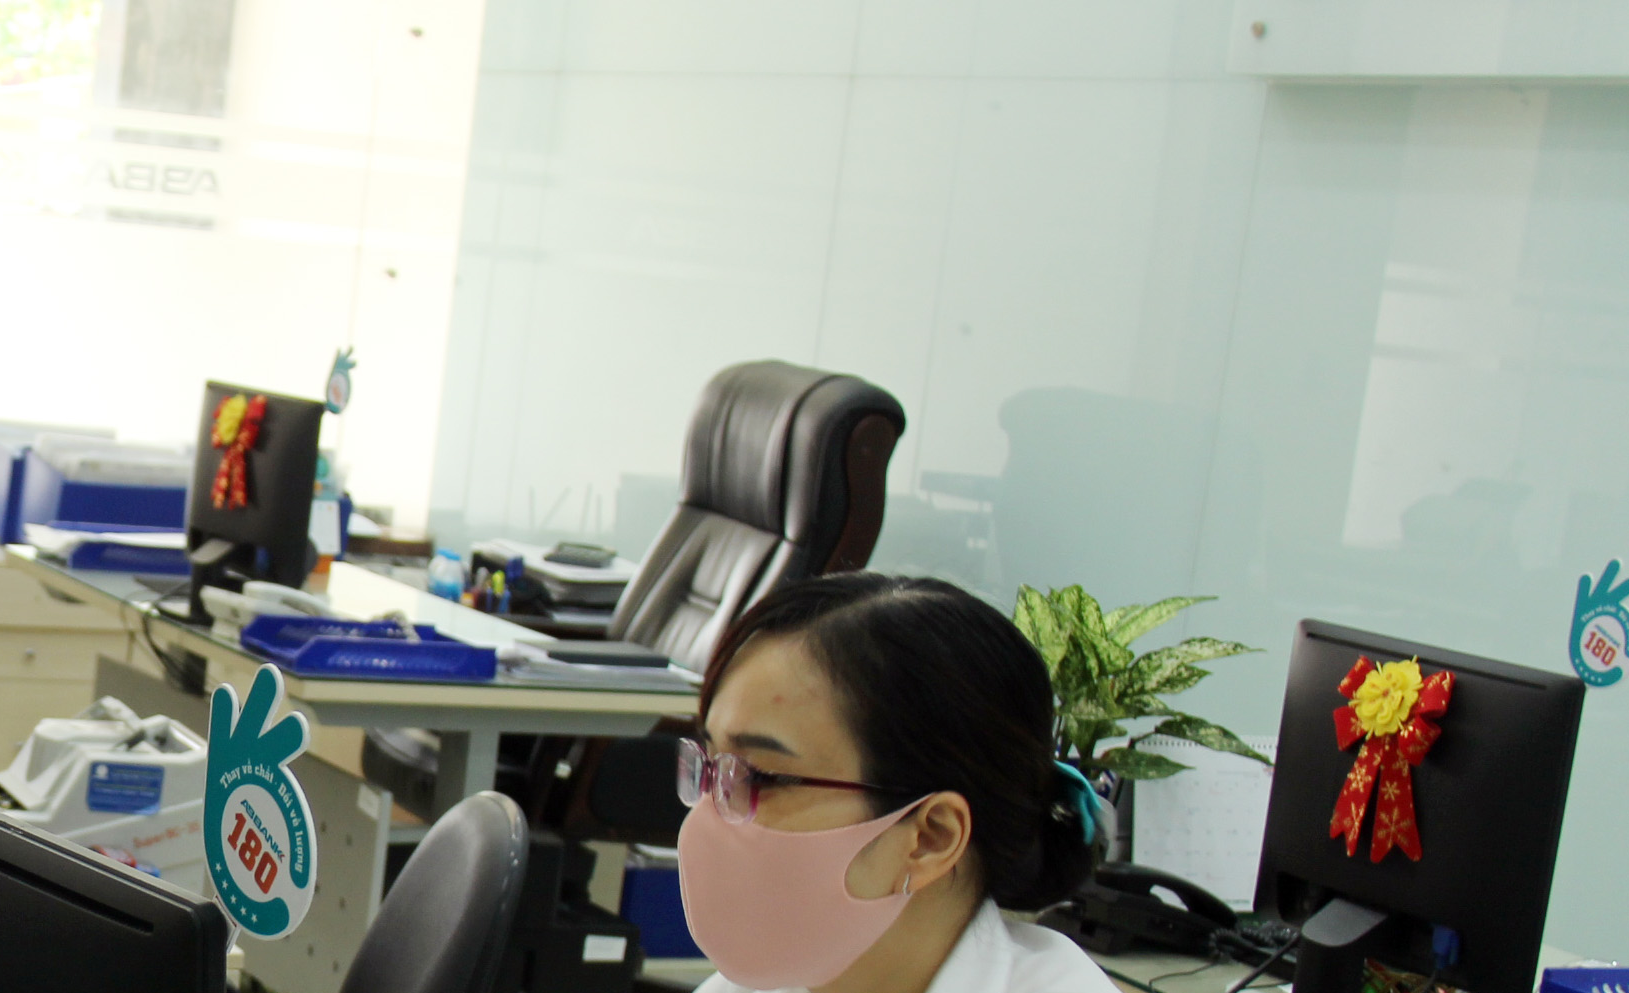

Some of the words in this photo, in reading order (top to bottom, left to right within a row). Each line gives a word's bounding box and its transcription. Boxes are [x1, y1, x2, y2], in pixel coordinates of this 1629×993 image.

[1584, 630, 1616, 666] 180
[220, 766, 241, 789] Thay
[227, 812, 278, 894] 180
[240, 799, 285, 863] ABBANK
